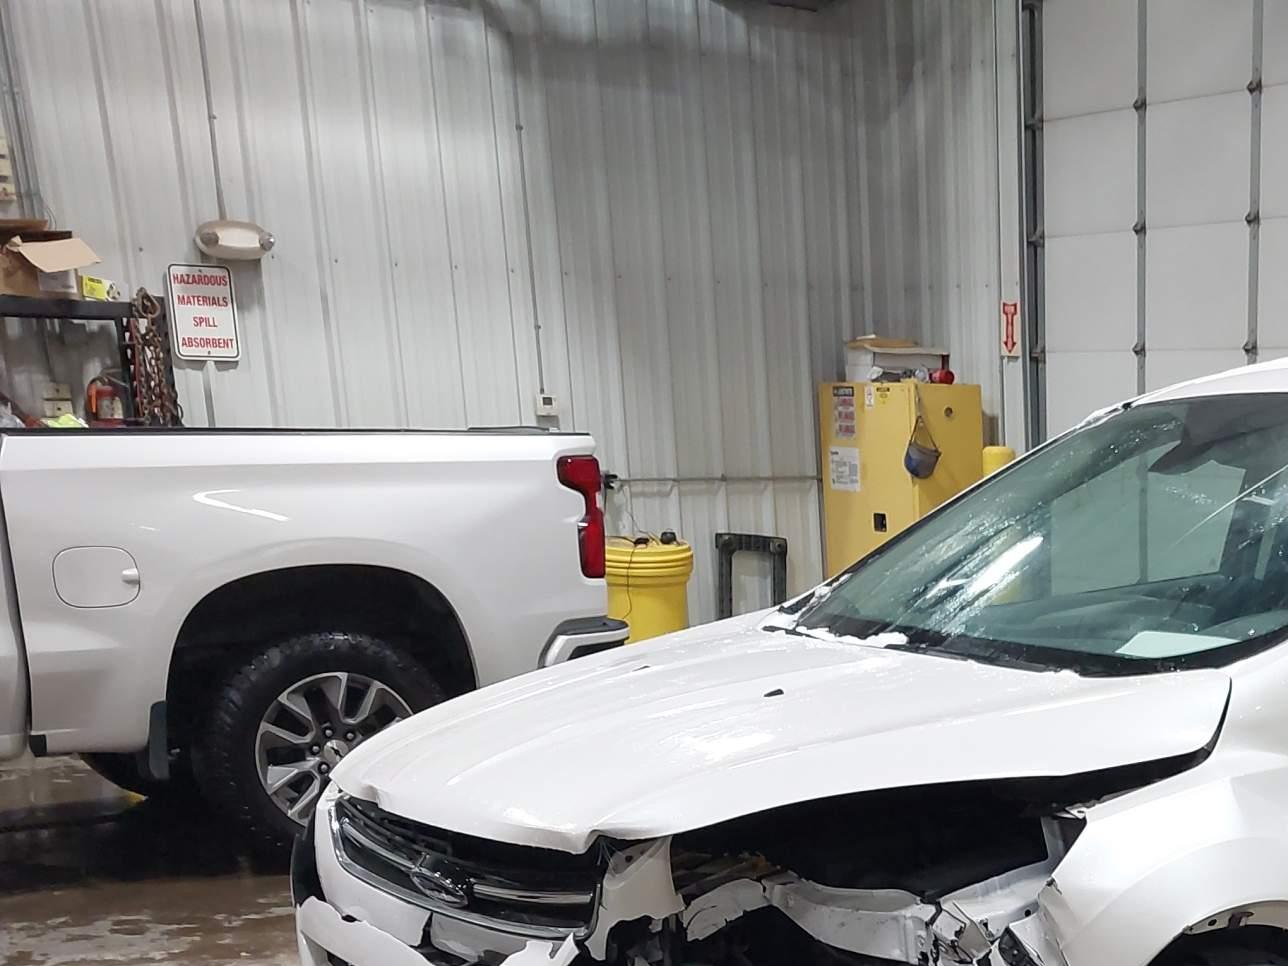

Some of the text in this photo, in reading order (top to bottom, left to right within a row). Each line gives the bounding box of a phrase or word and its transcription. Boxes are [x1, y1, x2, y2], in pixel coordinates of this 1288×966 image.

[172, 273, 228, 287] HAZARDOUS
[177, 295, 228, 307] MATERIALS
[192, 316, 218, 328] SPILL
[181, 337, 234, 349] ABSORBENT
